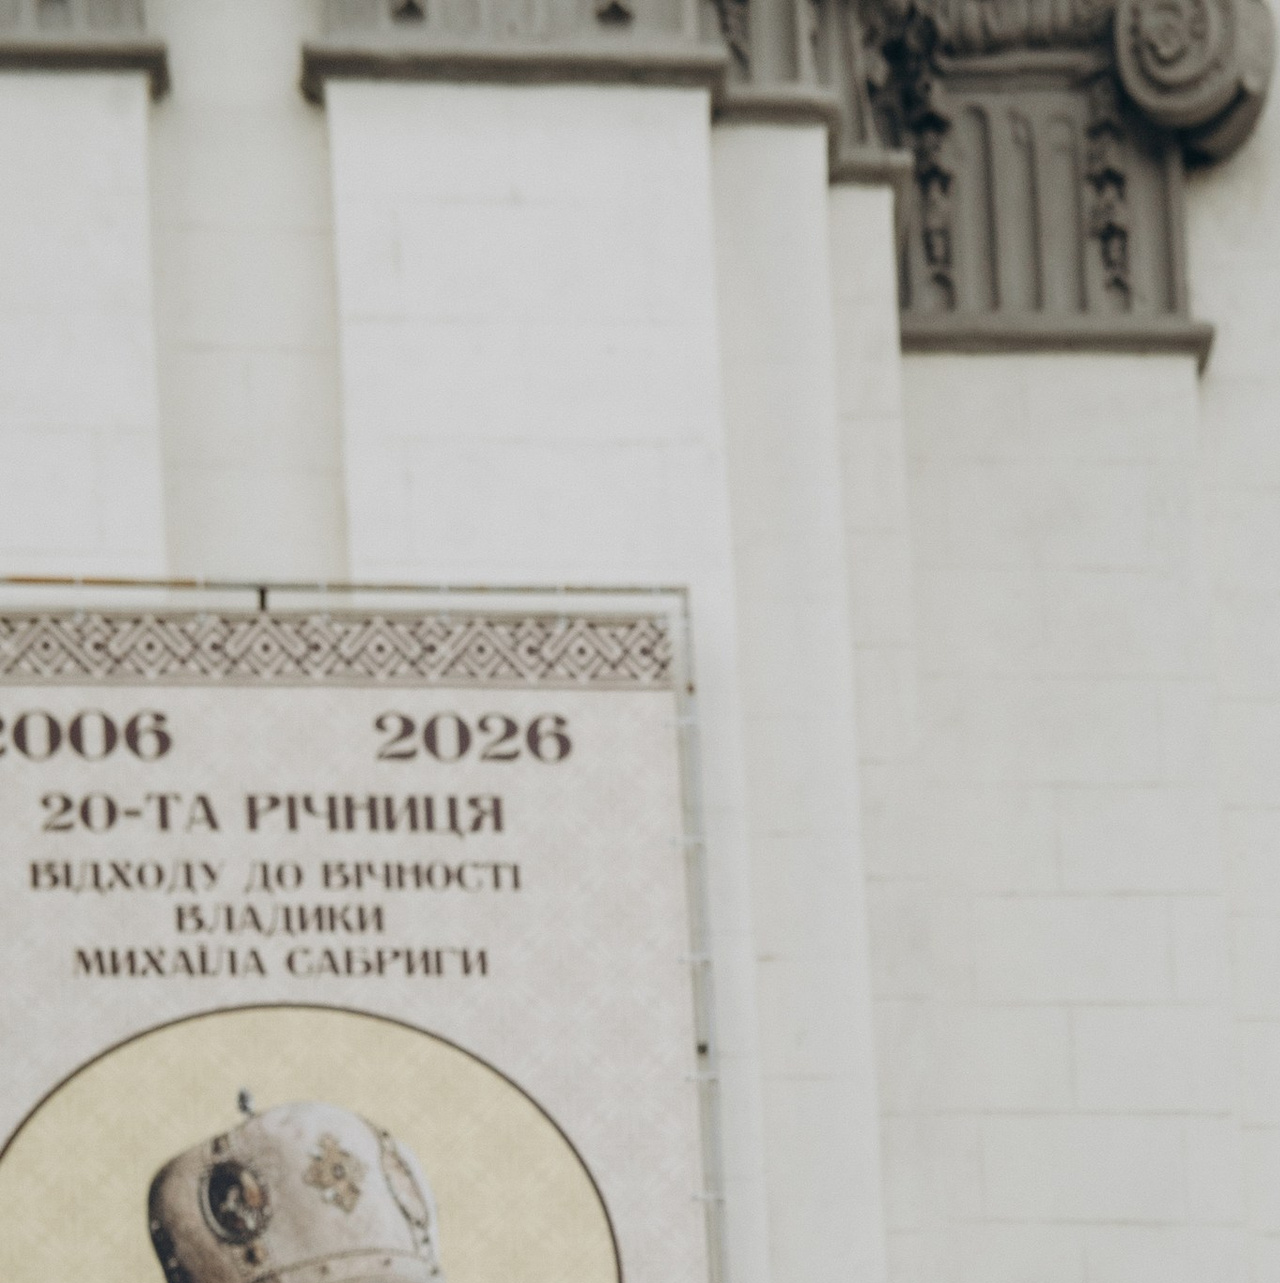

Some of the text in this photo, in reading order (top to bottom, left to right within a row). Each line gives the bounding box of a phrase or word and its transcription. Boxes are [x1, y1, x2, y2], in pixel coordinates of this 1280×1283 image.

[0, 711, 574, 764] 006 2026
[40, 792, 506, 838] 20-ТА РІЧНИЦЯ
[28, 860, 523, 894] ВІДХОДУ ДО ВІЧНОСТІ
[174, 903, 386, 938] ВЛАДИКИ
[284, 946, 489, 979] САБРИГИ
